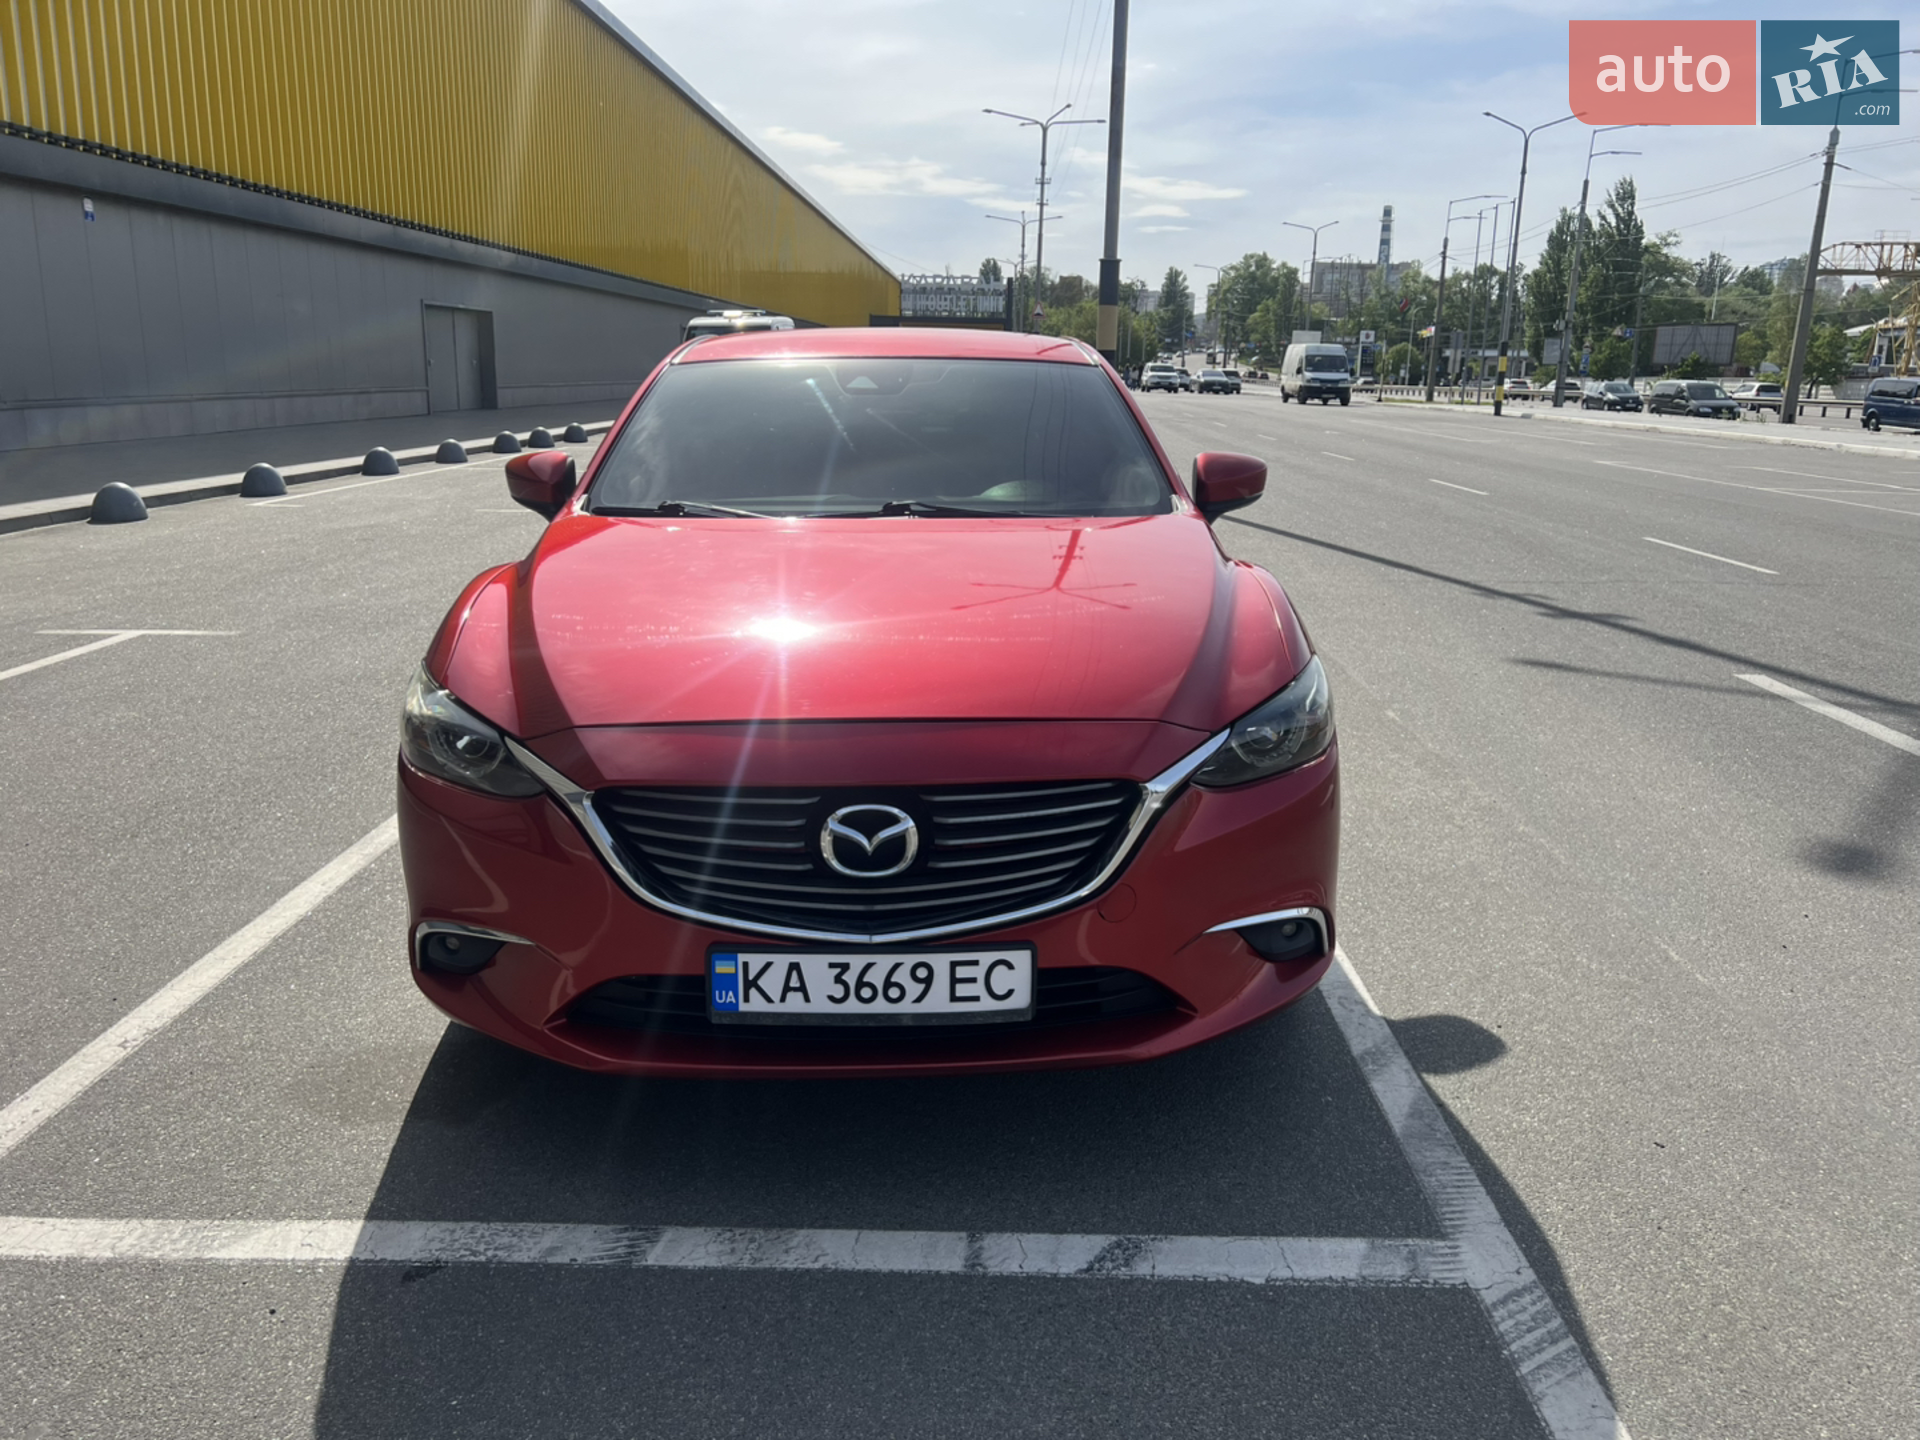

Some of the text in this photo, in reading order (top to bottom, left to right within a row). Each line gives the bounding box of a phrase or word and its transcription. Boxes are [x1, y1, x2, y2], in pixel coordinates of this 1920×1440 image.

[742, 958, 1016, 1005] KA 3669 EC
[715, 990, 737, 1004] UA
